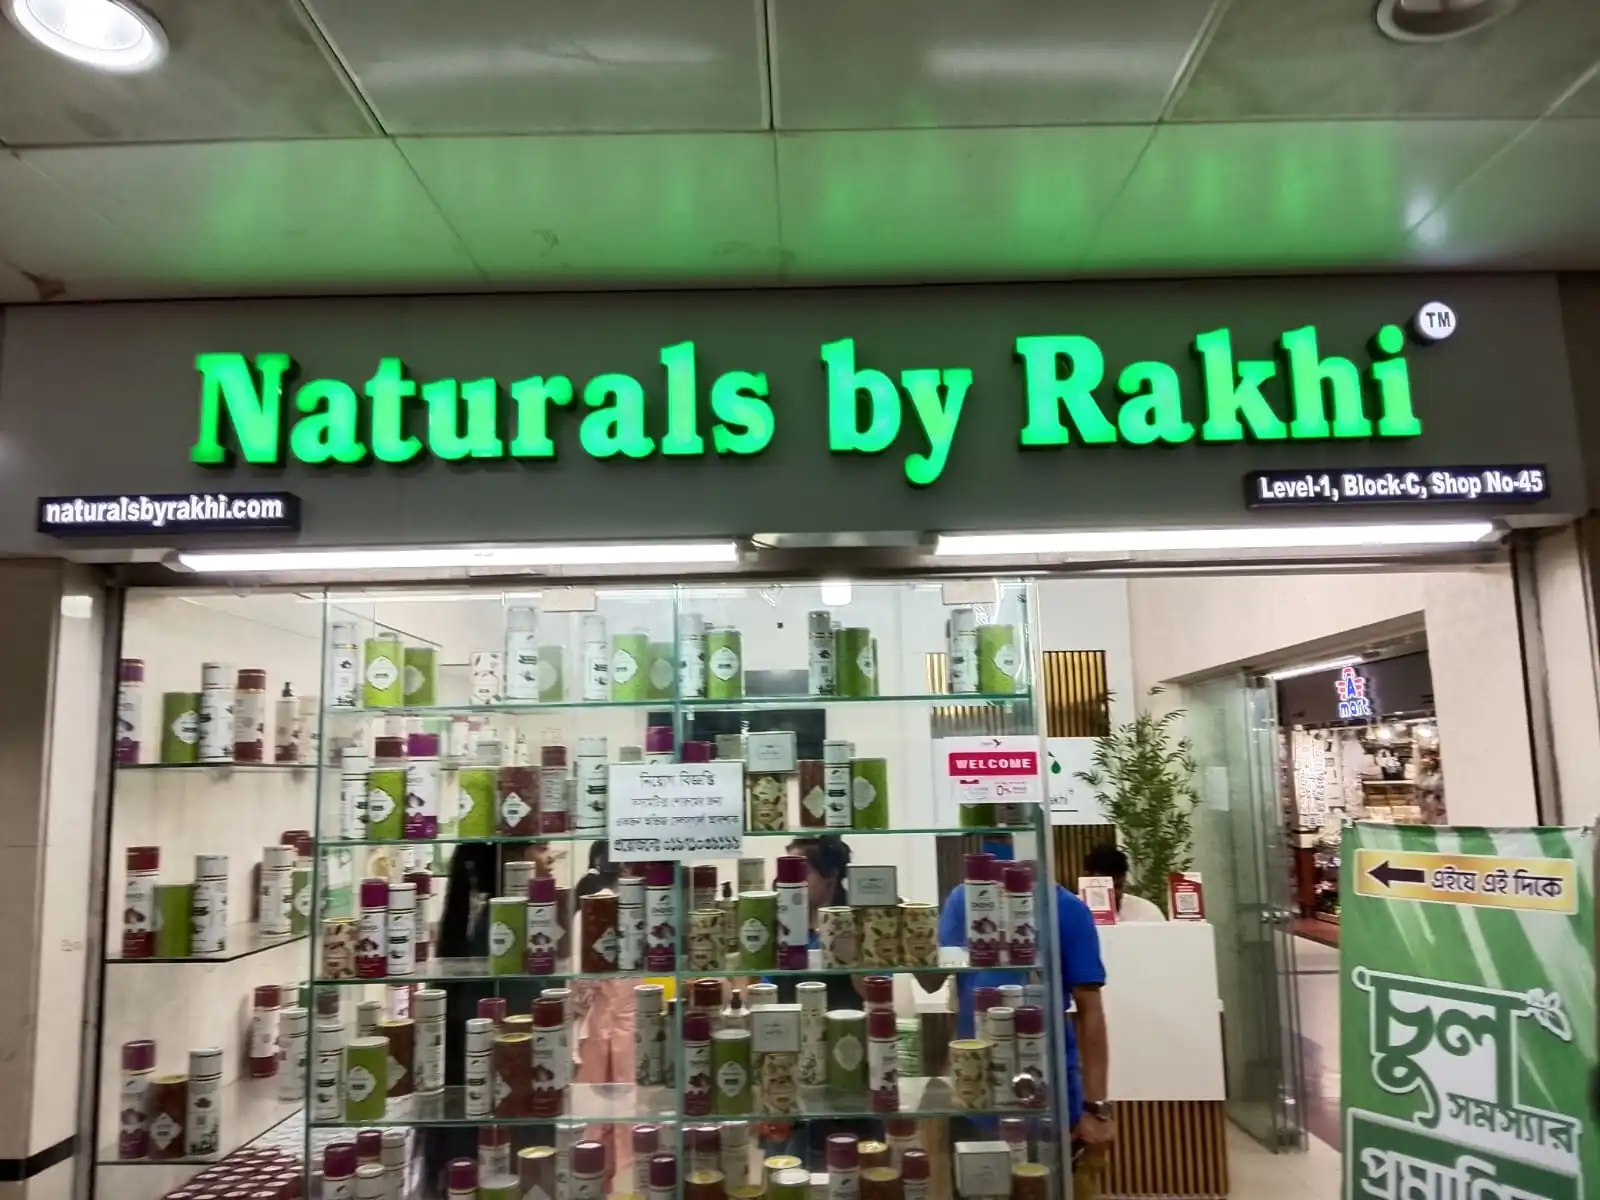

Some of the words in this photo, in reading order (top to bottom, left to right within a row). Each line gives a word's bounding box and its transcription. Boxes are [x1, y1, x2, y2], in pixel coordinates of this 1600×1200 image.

[1426, 311, 1451, 328] TM
[191, 340, 775, 464] Naturals
[820, 337, 973, 485] by
[1015, 324, 1422, 446] Rakhi
[1259, 475, 1338, 501] Level-1,
[1343, 472, 1427, 498] Block-C,
[1430, 471, 1482, 498] Shop
[1484, 470, 1544, 493] No-45
[44, 494, 284, 526] naturalsbyrakhi.com
[955, 758, 1032, 769] WELCOME
[1481, 869, 1508, 895] এই
[1512, 868, 1563, 898] দিকে
[1354, 967, 1530, 1130] চুল
[1446, 1092, 1576, 1152] সমস্যার
